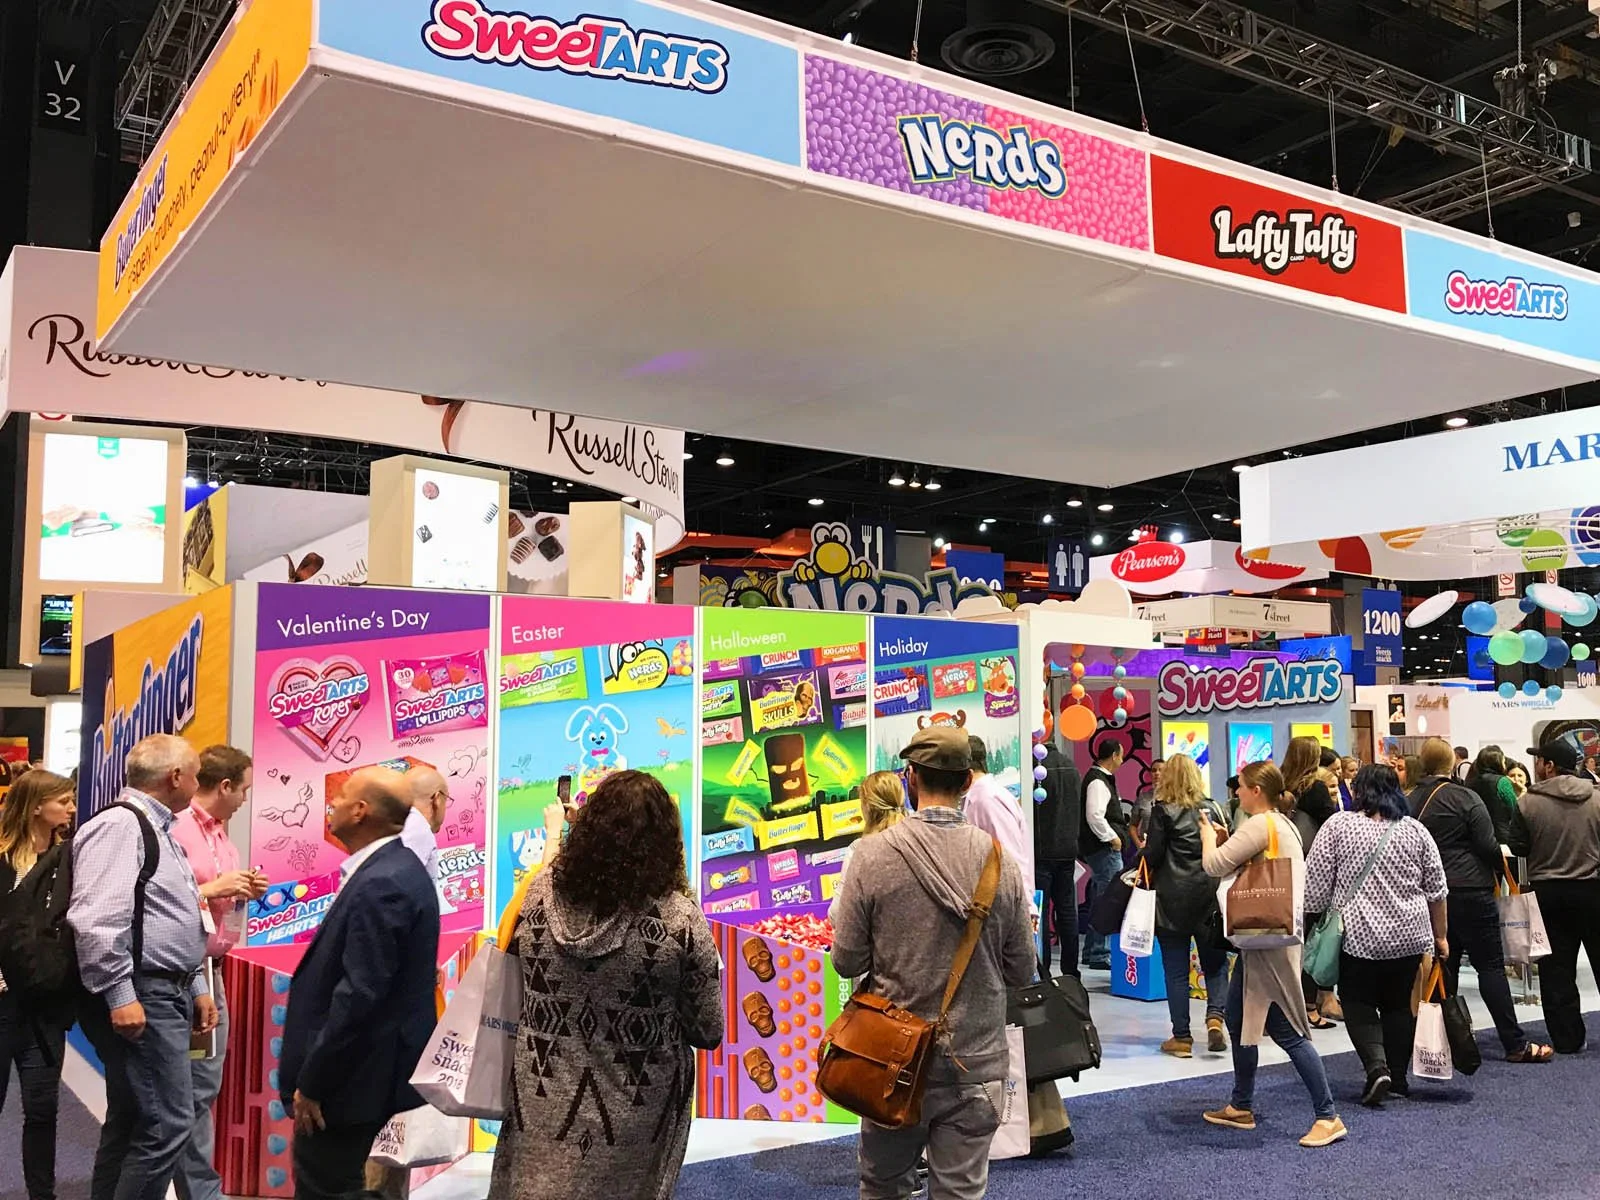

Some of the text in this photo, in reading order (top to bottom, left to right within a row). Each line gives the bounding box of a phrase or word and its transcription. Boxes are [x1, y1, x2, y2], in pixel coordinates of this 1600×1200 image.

[54, 60, 76, 85] V
[45, 92, 81, 121] 32
[115, 152, 168, 290] Butterfinger
[1213, 208, 1356, 271] Laffy Taffy
[1446, 273, 1568, 318] SweeTARTS
[1117, 550, 1181, 577] Pearson's
[277, 609, 430, 638] Valentine's Day
[511, 626, 565, 644] Easter
[1364, 609, 1401, 636] 1200
[710, 631, 787, 651] Halloween
[879, 637, 929, 657] Holiday
[762, 650, 798, 665] CRUNCH
[874, 680, 917, 700] CRUNCH
[1159, 661, 1341, 713] SweeTARTS
[763, 705, 794, 722] SKULLS
[1491, 701, 1520, 709] MARS
[380, 1144, 399, 1155] 2018
